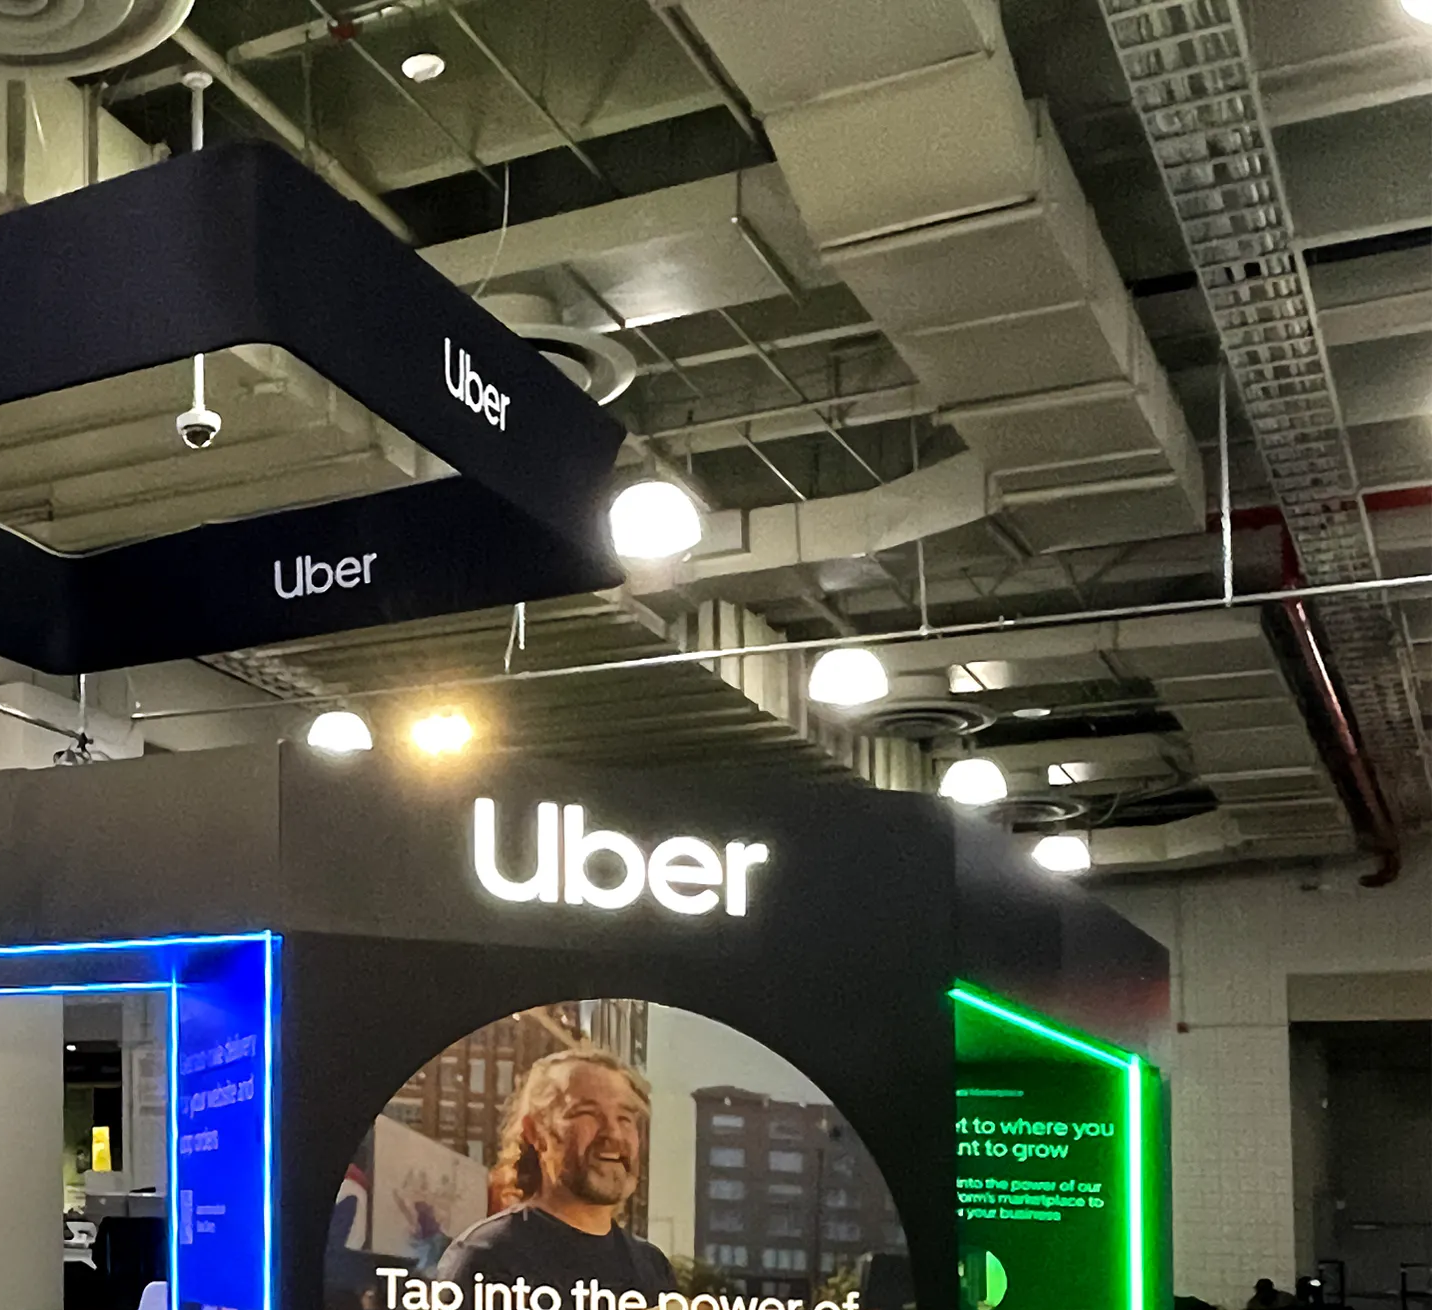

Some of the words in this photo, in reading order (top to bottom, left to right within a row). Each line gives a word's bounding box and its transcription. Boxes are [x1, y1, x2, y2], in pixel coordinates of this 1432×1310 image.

[443, 338, 510, 431] Uber
[273, 552, 377, 600] Uber
[474, 797, 768, 916] Uber
[972, 1117, 996, 1134] to
[1000, 1118, 1068, 1136] where
[1072, 1122, 1114, 1140] you
[957, 1140, 980, 1156] nt
[984, 1140, 1008, 1157] to
[1012, 1143, 1069, 1162] grow
[1059, 1179, 1075, 1192] of
[1077, 1182, 1102, 1193] our
[1088, 1196, 1105, 1208] to
